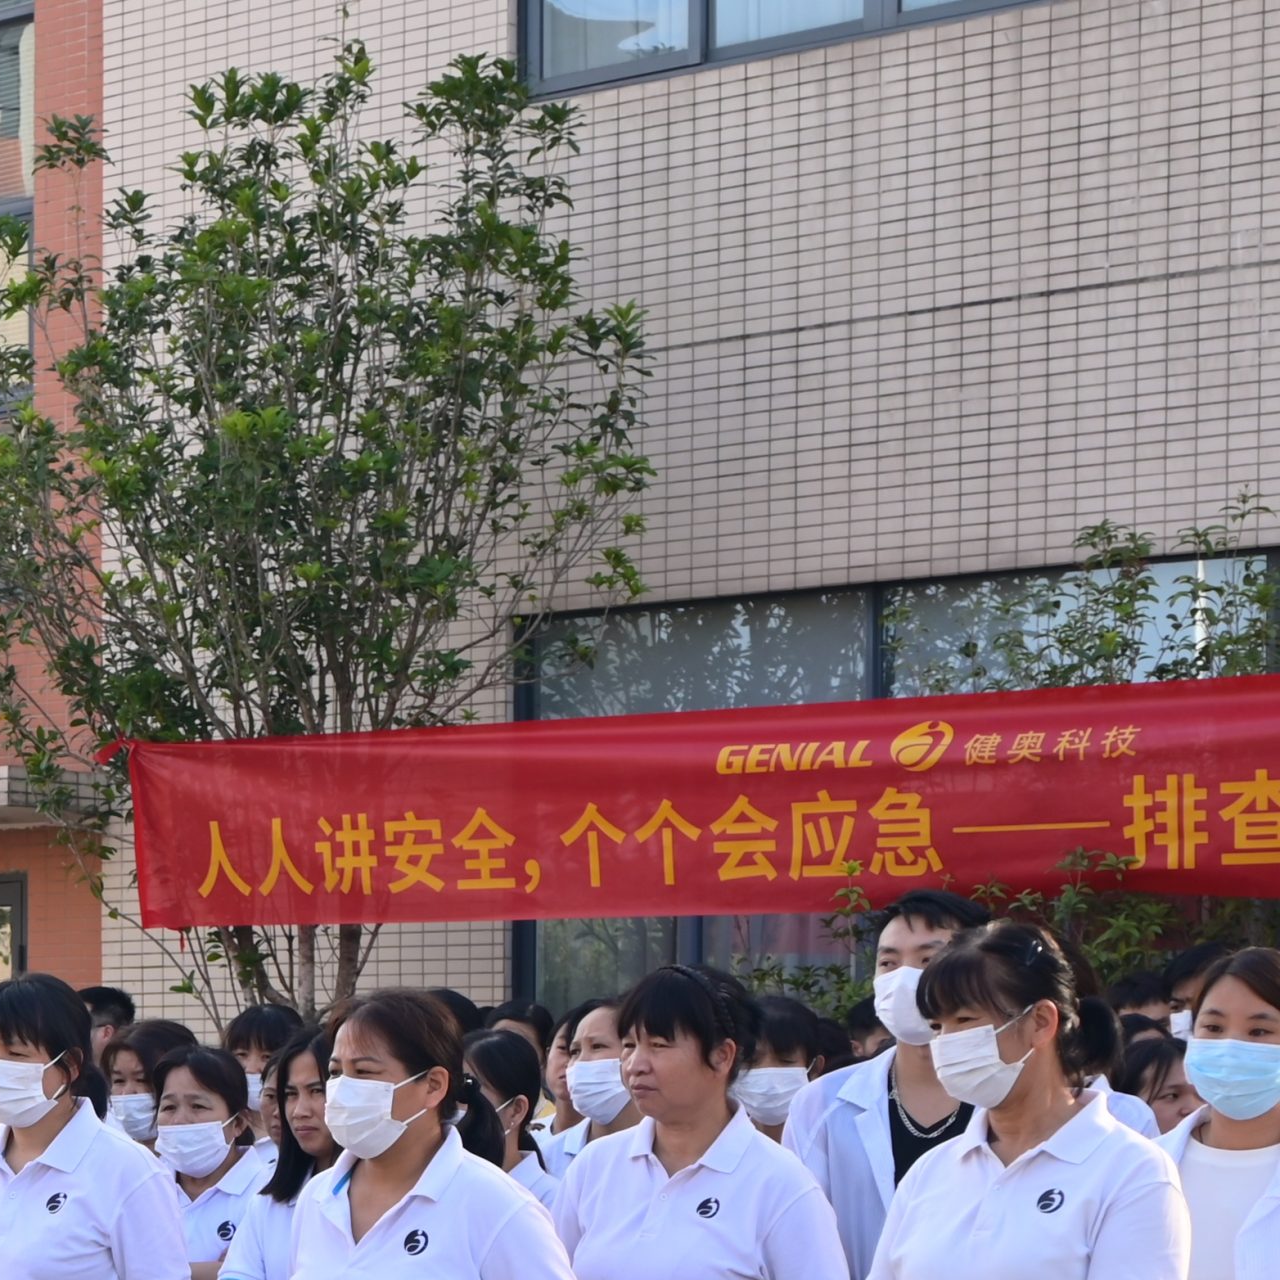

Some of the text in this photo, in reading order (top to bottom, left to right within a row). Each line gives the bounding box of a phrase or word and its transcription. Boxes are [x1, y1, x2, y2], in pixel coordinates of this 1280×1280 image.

[715, 740, 873, 775] GENIAL
[963, 723, 1142, 766] 健奥科技
